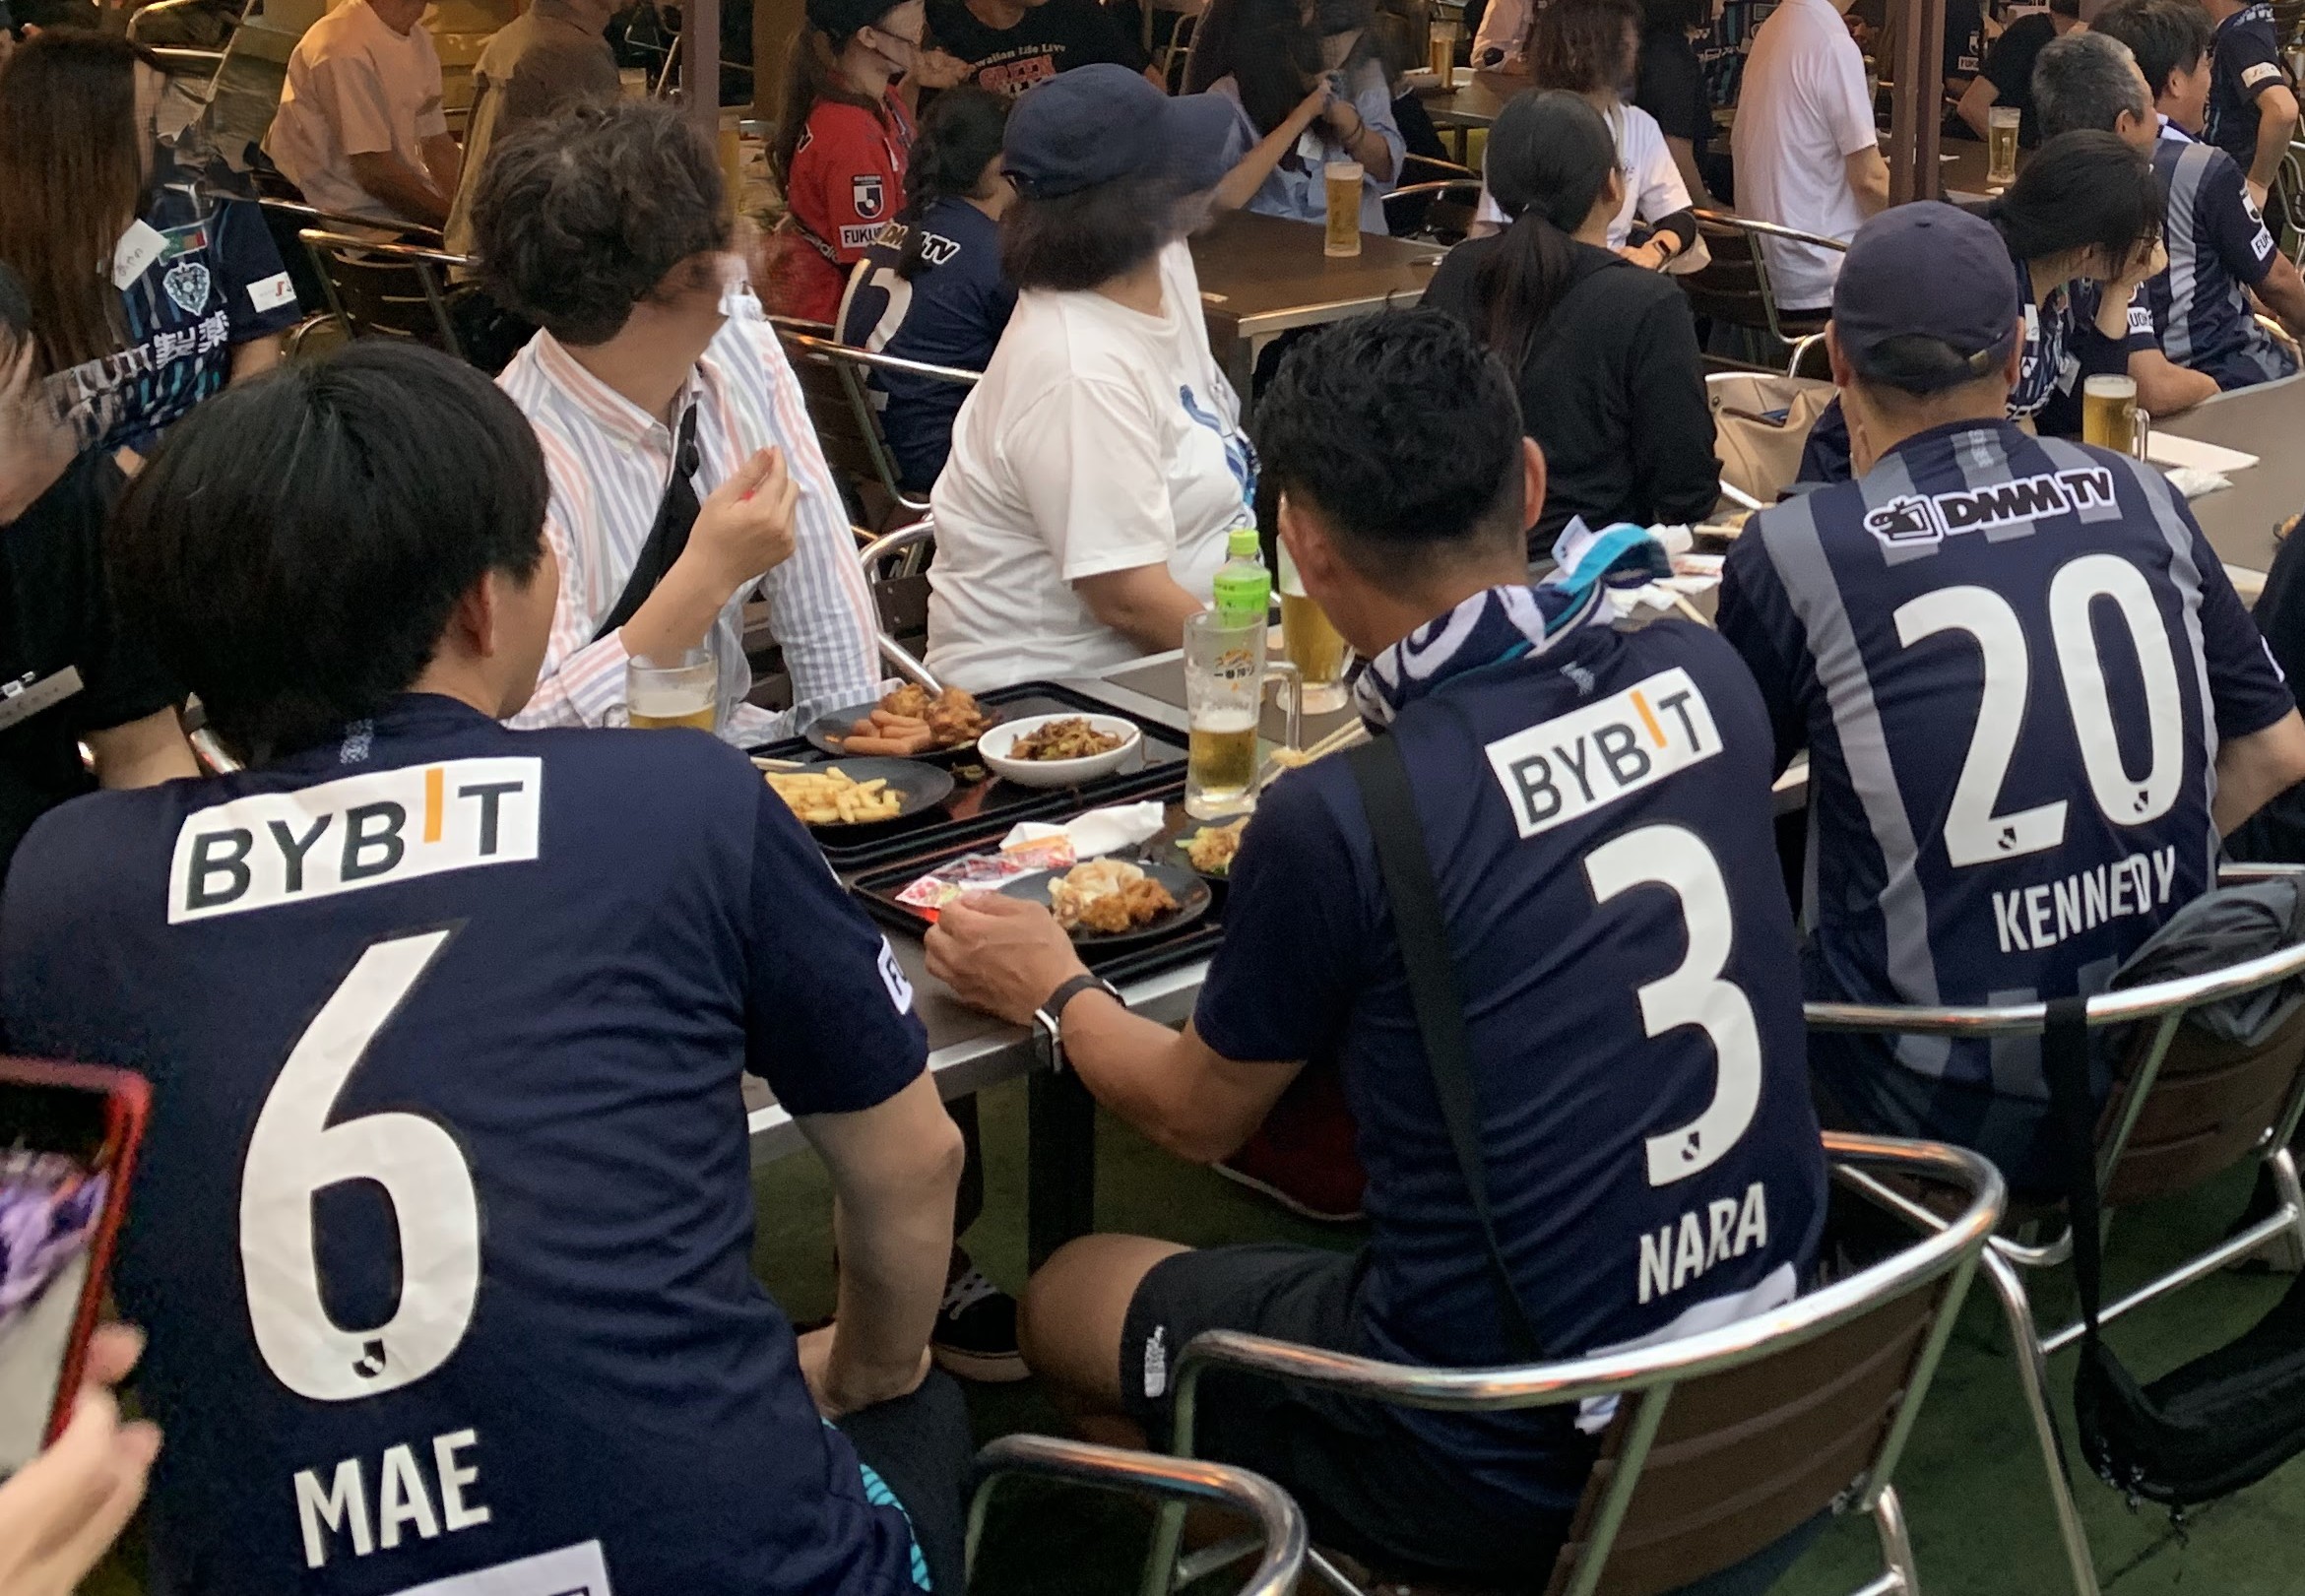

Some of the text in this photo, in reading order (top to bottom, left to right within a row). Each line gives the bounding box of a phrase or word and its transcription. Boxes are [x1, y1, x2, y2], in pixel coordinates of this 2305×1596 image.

[924, 235, 958, 263] TV
[1937, 470, 2113, 532] DMM TV
[1508, 689, 1700, 826] BYBIT
[1893, 553, 2184, 867] 20
[185, 767, 525, 912] BYBIT
[1992, 845, 2175, 953] KENNEDY
[1584, 824, 1762, 1186] 3
[239, 929, 480, 1402] 6
[1638, 1181, 1767, 1305] NARA
[293, 1428, 491, 1569] MAE
